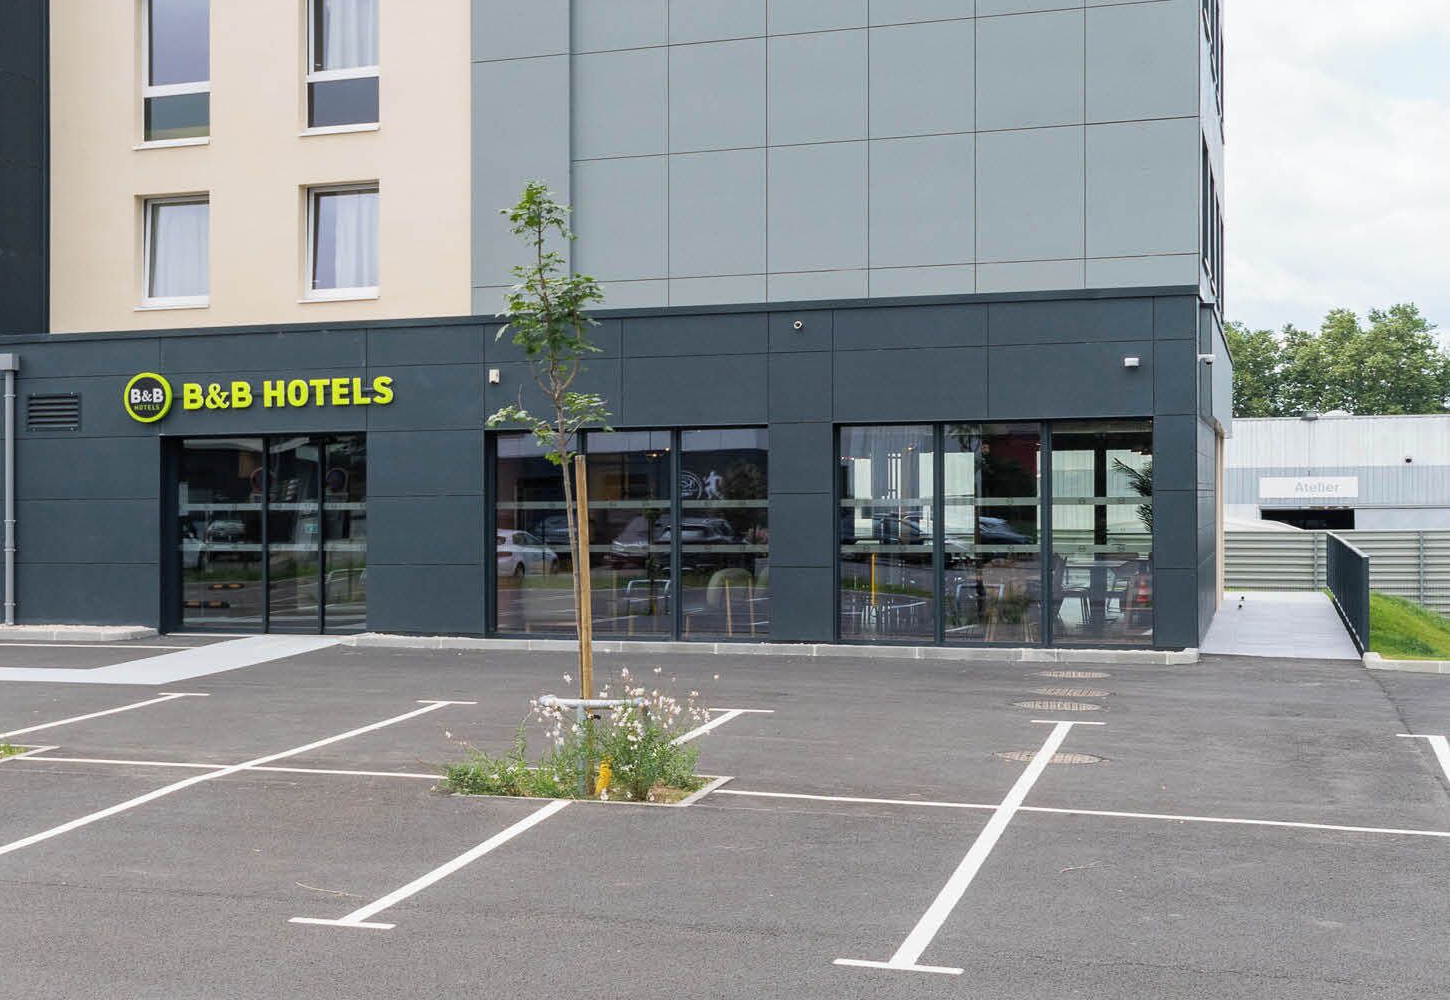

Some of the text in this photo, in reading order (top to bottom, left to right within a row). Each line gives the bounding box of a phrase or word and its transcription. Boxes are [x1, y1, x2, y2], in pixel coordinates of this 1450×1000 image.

[130, 388, 164, 403] B&B
[183, 376, 394, 410] B&B HOTELS
[133, 403, 160, 411] HOTELS
[1295, 481, 1341, 493] Atelier
